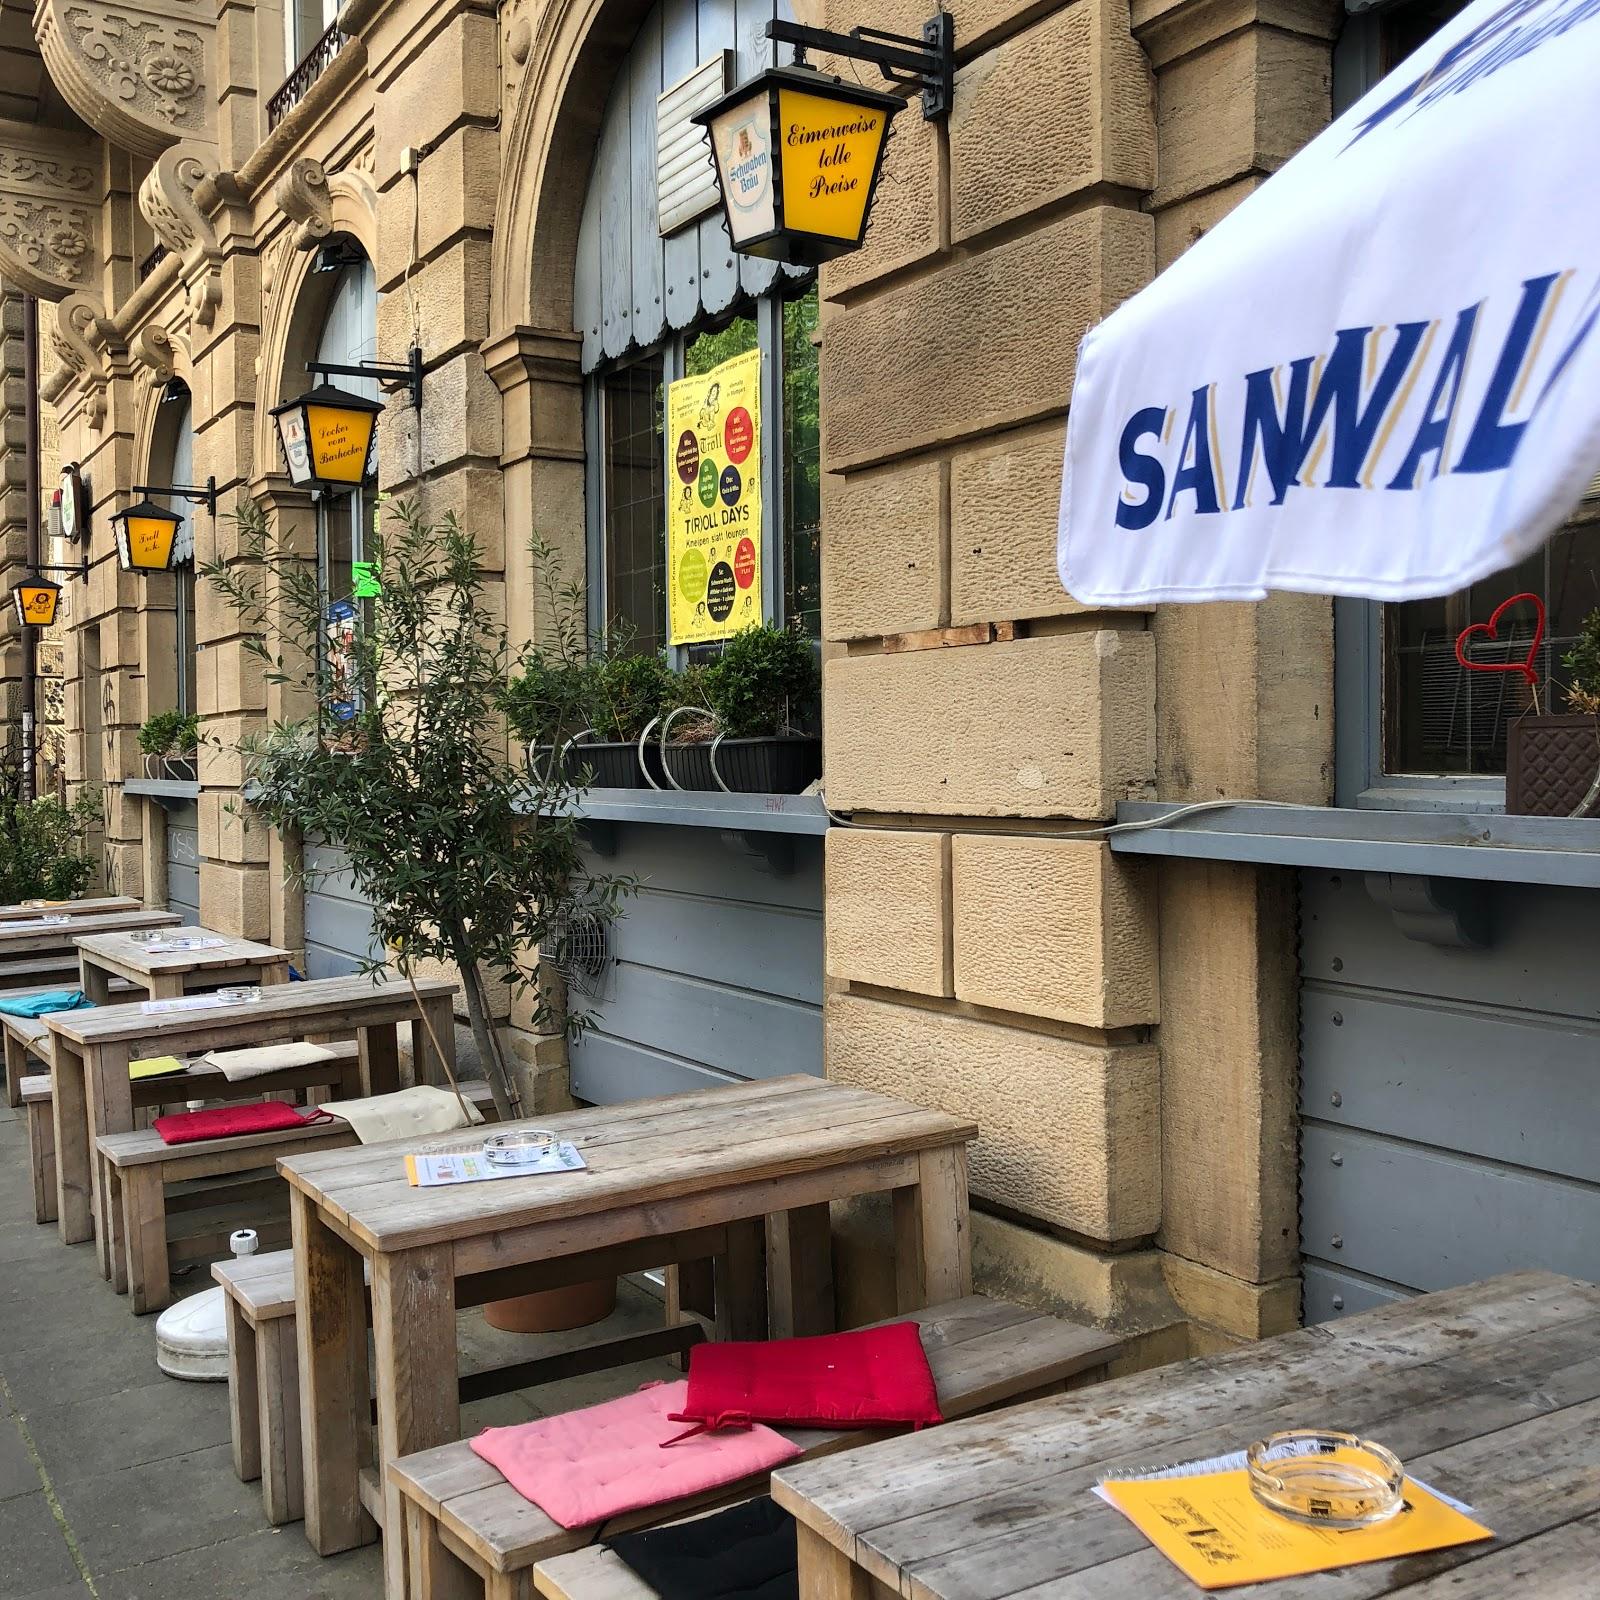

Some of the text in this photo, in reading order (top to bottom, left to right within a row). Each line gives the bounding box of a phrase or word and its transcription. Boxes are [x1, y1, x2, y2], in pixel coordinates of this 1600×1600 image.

[787, 114, 877, 147] Eimerweise
[729, 152, 767, 182] Schwaben
[809, 174, 858, 199] Preise
[1114, 268, 1600, 530] SANWAL
[318, 423, 350, 439] Locker
[327, 436, 347, 447] vom
[319, 443, 363, 465] Barhocker
[700, 433, 722, 454] Troll
[684, 504, 750, 535] T(R)OLL DAYS
[685, 527, 749, 548] Kneipen statt loungen
